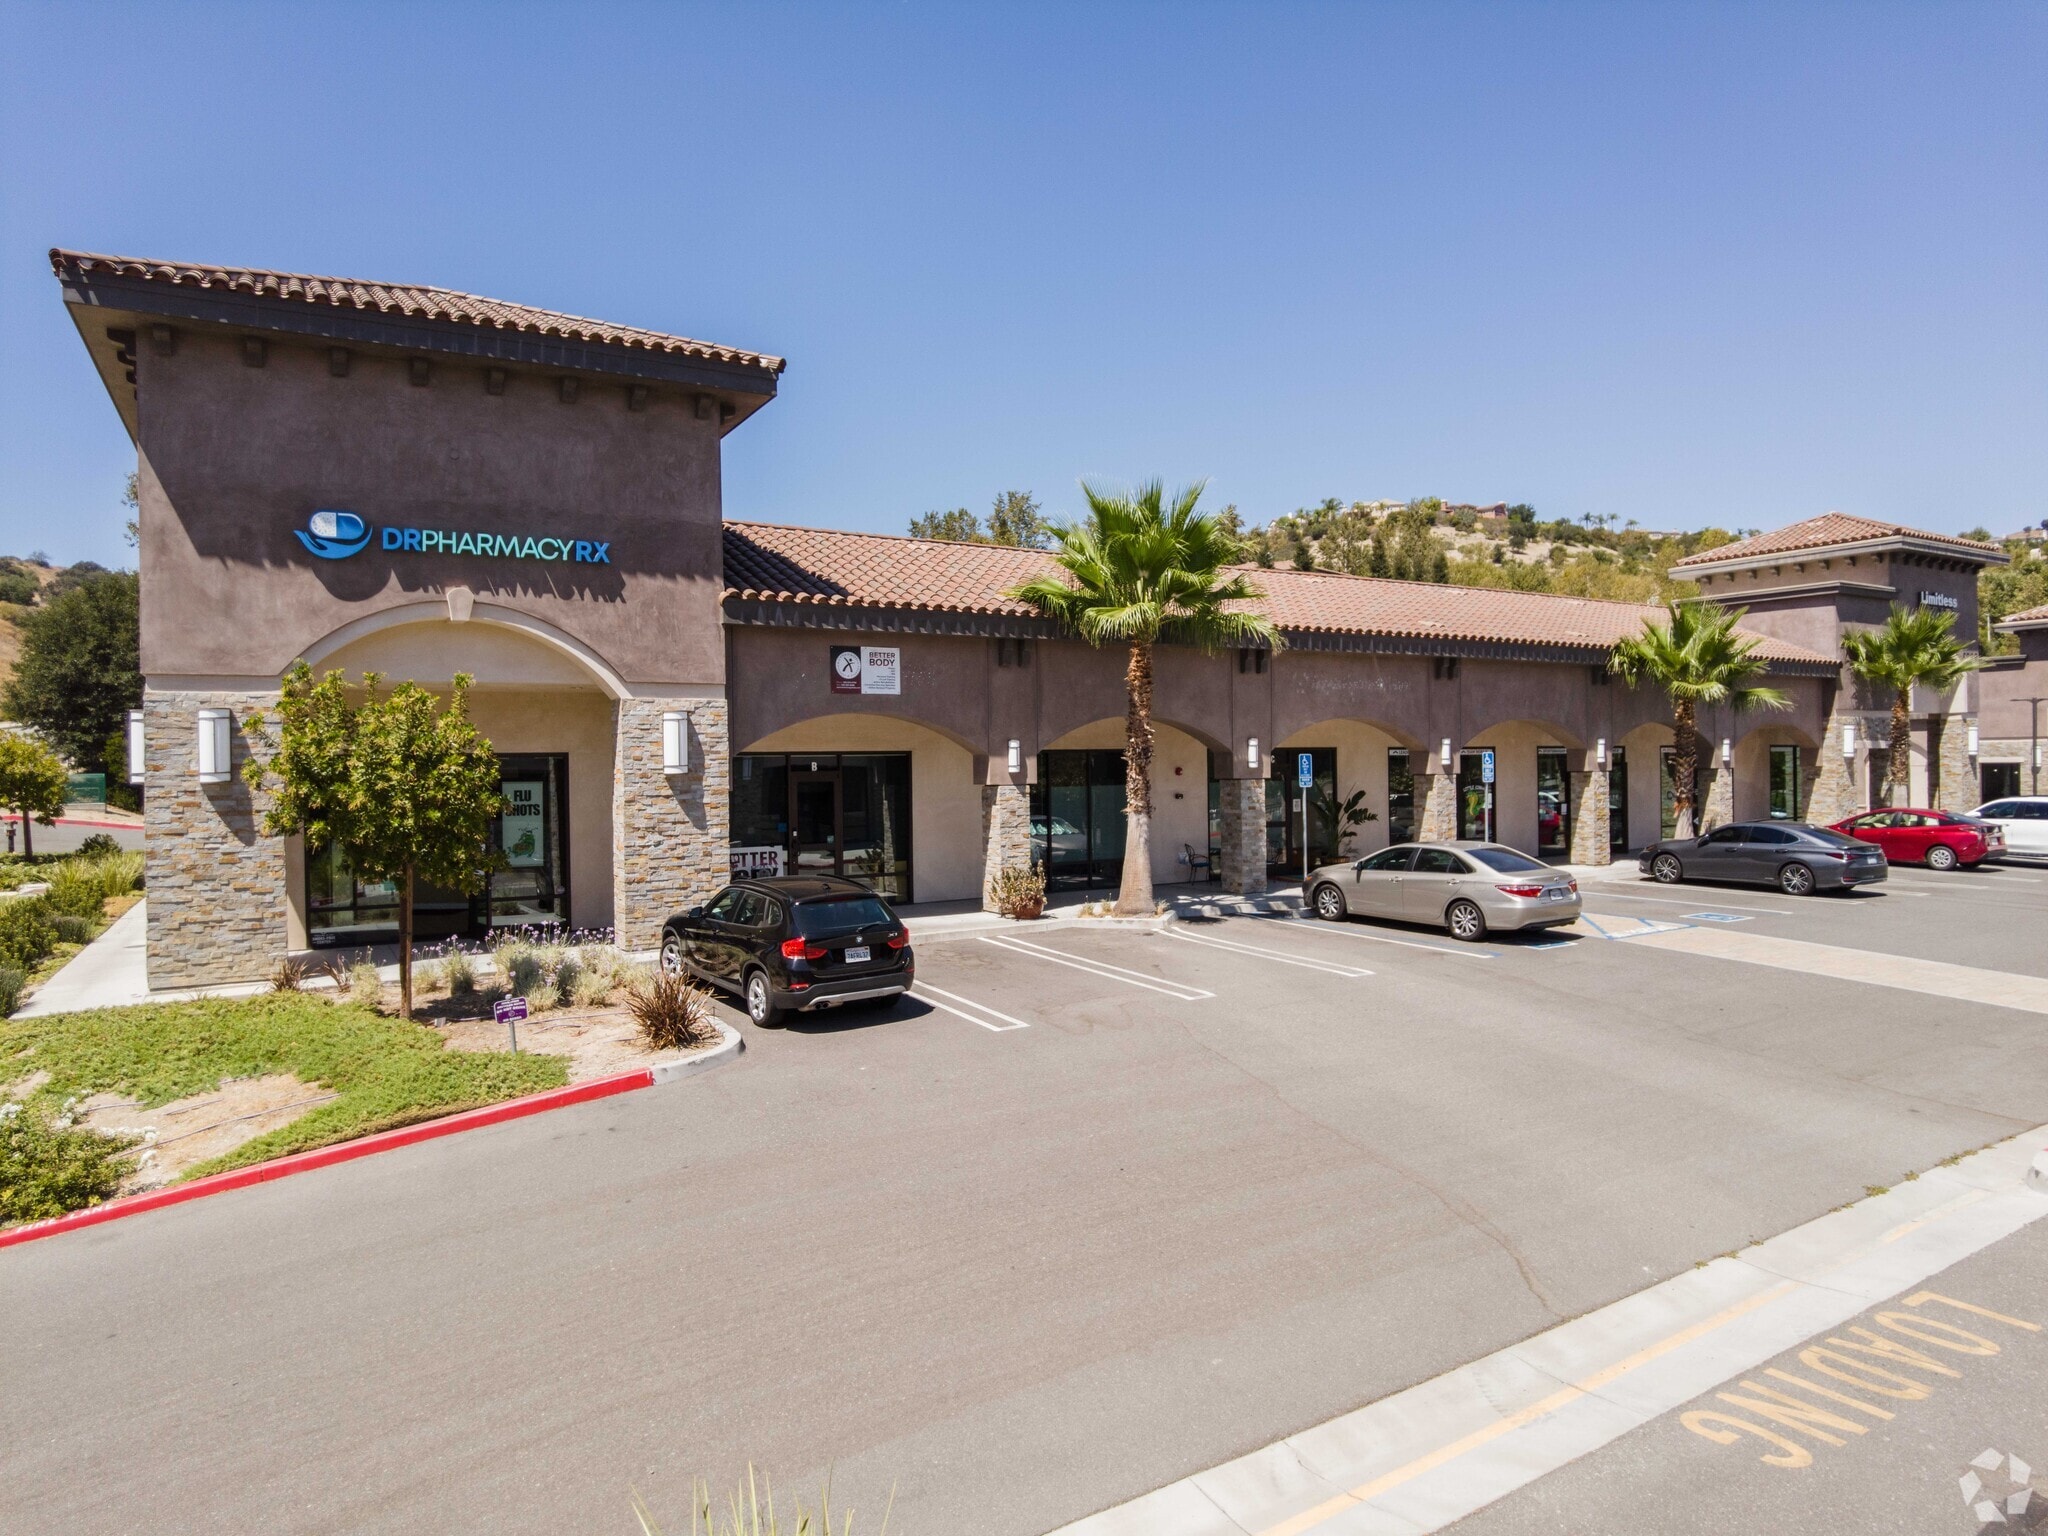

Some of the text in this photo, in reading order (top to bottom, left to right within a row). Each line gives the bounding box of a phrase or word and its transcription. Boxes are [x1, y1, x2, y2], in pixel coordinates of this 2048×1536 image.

[382, 526, 610, 563] DRPHARMACYRX
[1921, 591, 1958, 608] Limitless
[869, 651, 896, 659] BETTER
[869, 658, 896, 667] BODY
[811, 762, 818, 772] B
[513, 789, 532, 802] FLU
[69, 1204, 114, 1220] LANE
[1679, 1290, 2043, 1468] LOADING
